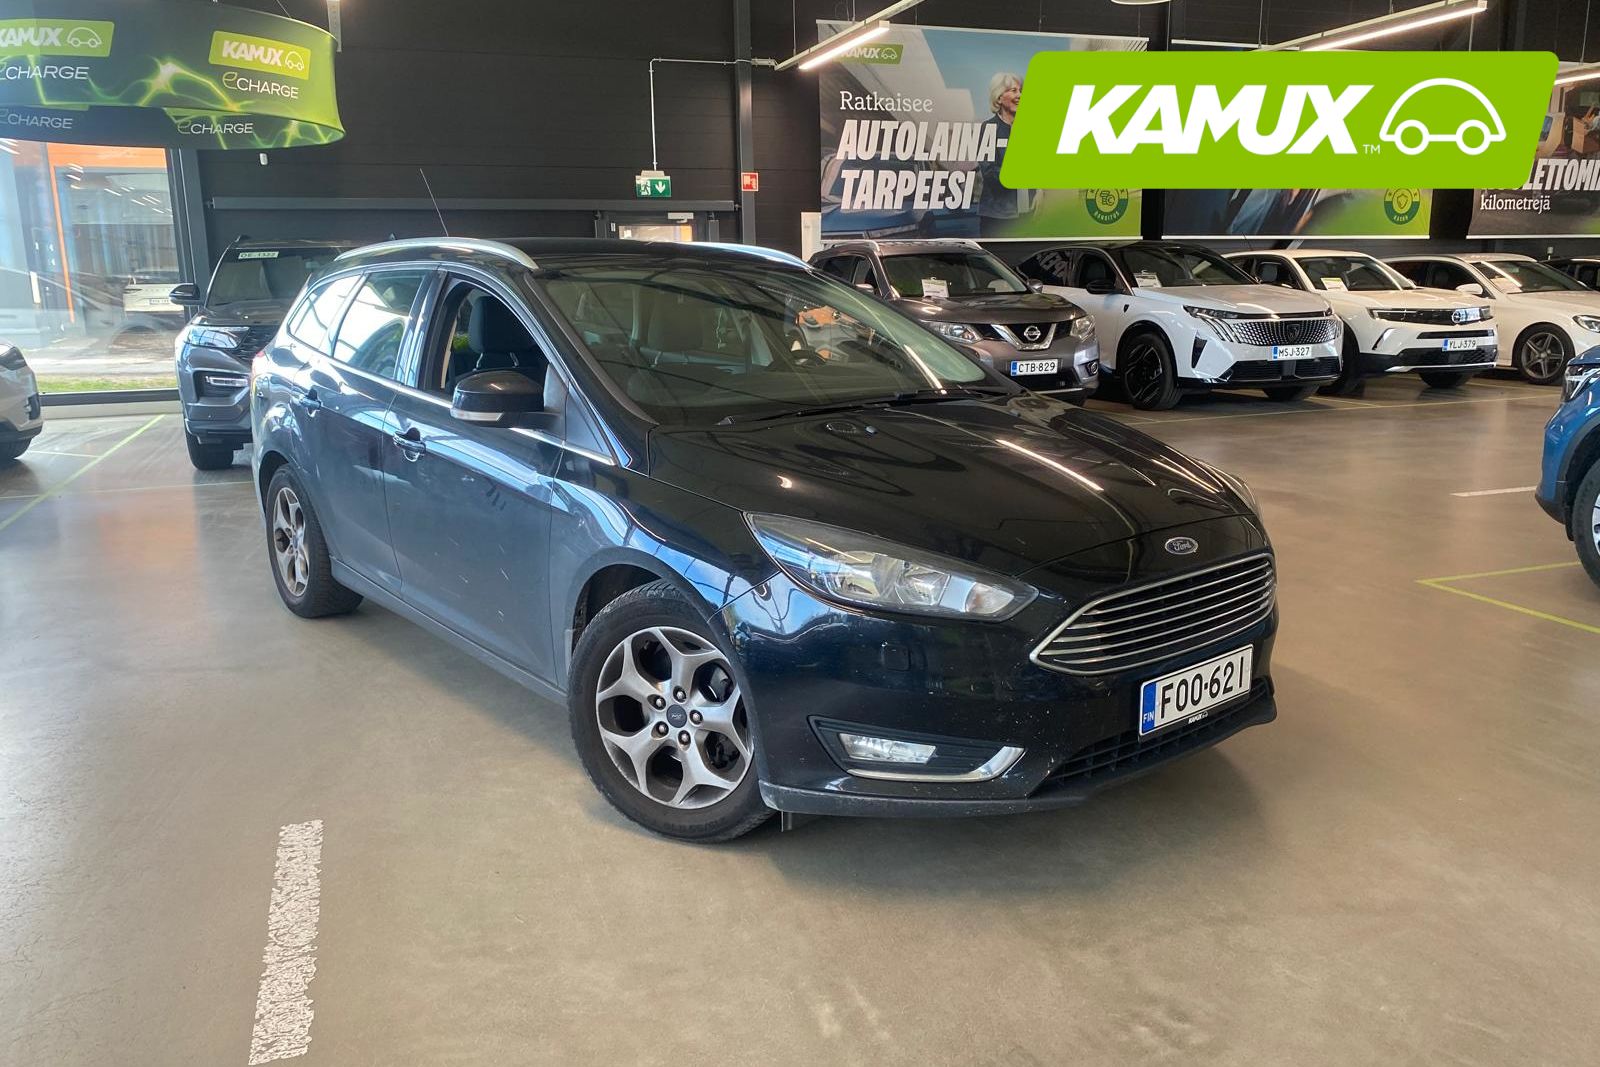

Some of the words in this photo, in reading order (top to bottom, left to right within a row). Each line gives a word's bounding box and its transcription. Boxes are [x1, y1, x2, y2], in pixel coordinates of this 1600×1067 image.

[222, 40, 284, 67] KAMUX
[841, 47, 881, 59] AMUX
[839, 90, 934, 113] Ratkaisee
[836, 119, 1008, 163] AUTOLAINA-
[840, 169, 976, 210] TARPEESI
[1480, 194, 1551, 215] kilometrejä
[1278, 346, 1311, 357] MSJ-327
[1449, 340, 1477, 349] YLJ-379
[1018, 362, 1056, 373] CTB-829
[1160, 656, 1245, 719] FOO-621
[1142, 710, 1155, 724] FIN
